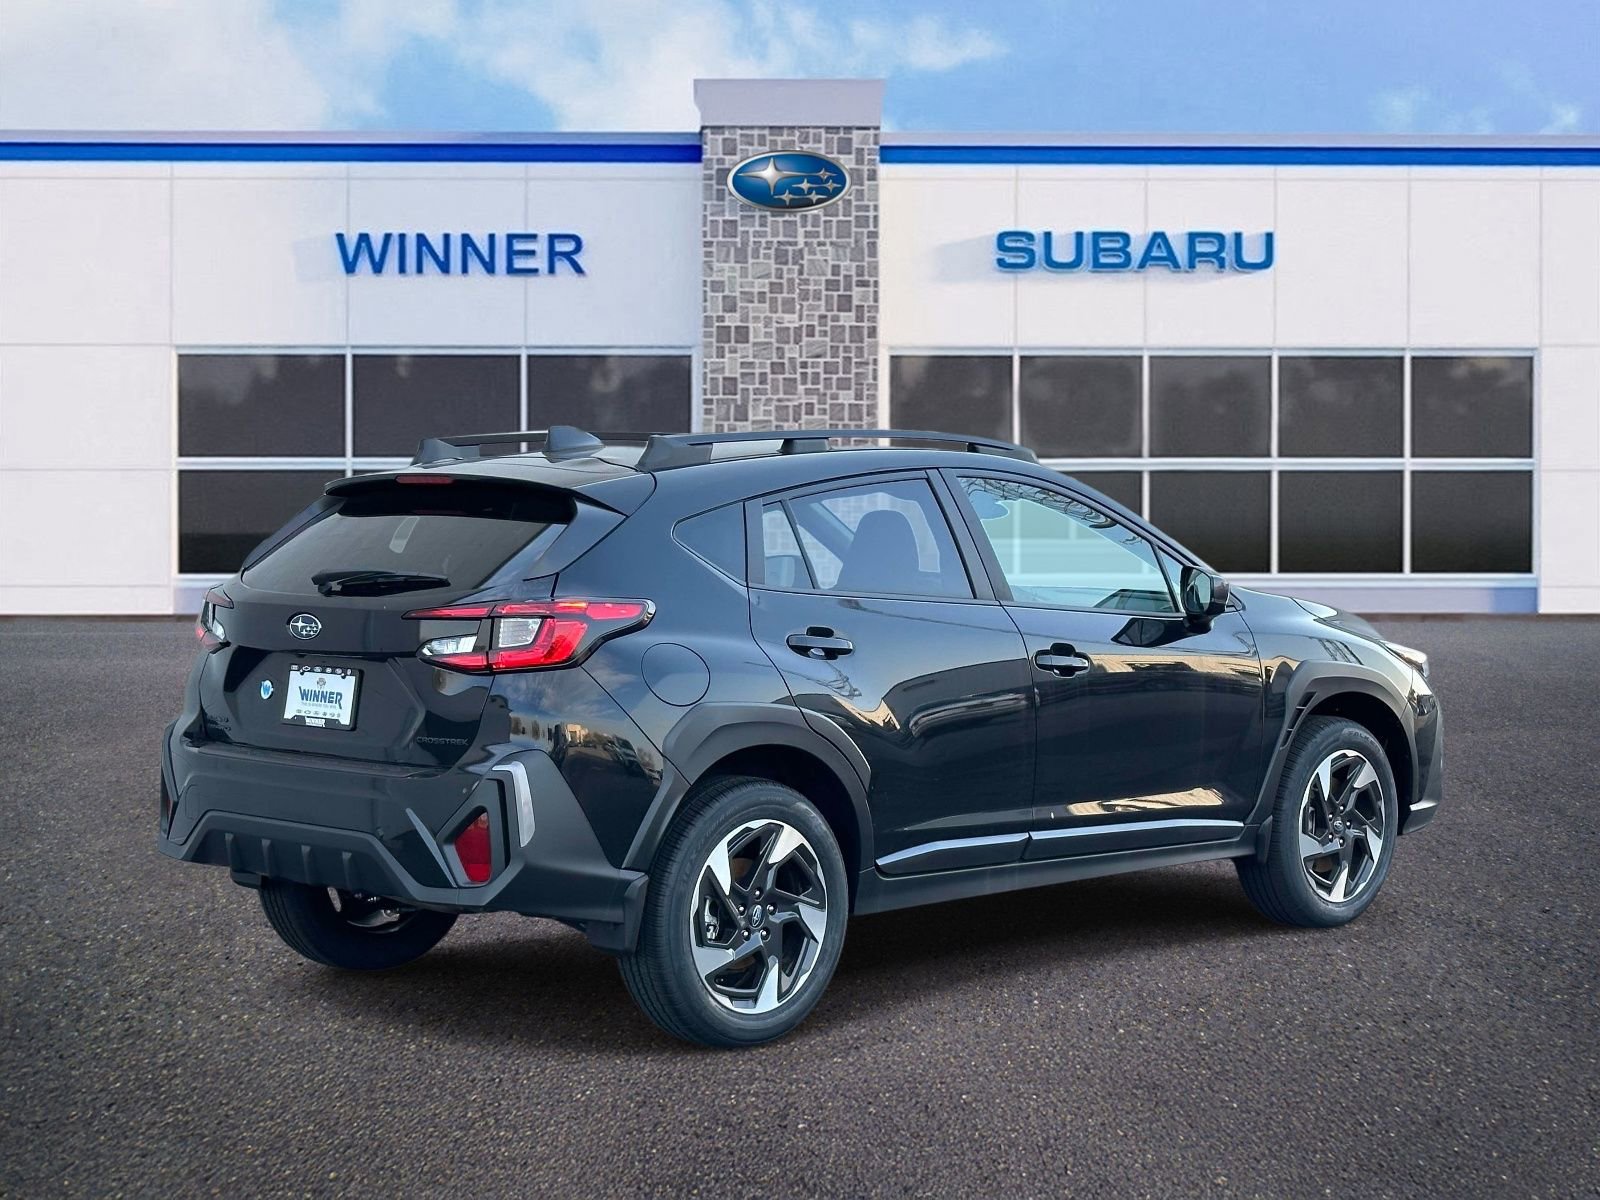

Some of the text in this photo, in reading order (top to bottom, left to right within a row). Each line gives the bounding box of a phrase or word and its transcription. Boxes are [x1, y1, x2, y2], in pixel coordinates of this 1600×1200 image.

[335, 232, 586, 275] WINNER
[995, 230, 1274, 271] SUBARU
[298, 685, 343, 710] WINNER
[416, 736, 469, 746] CROSSTREK
